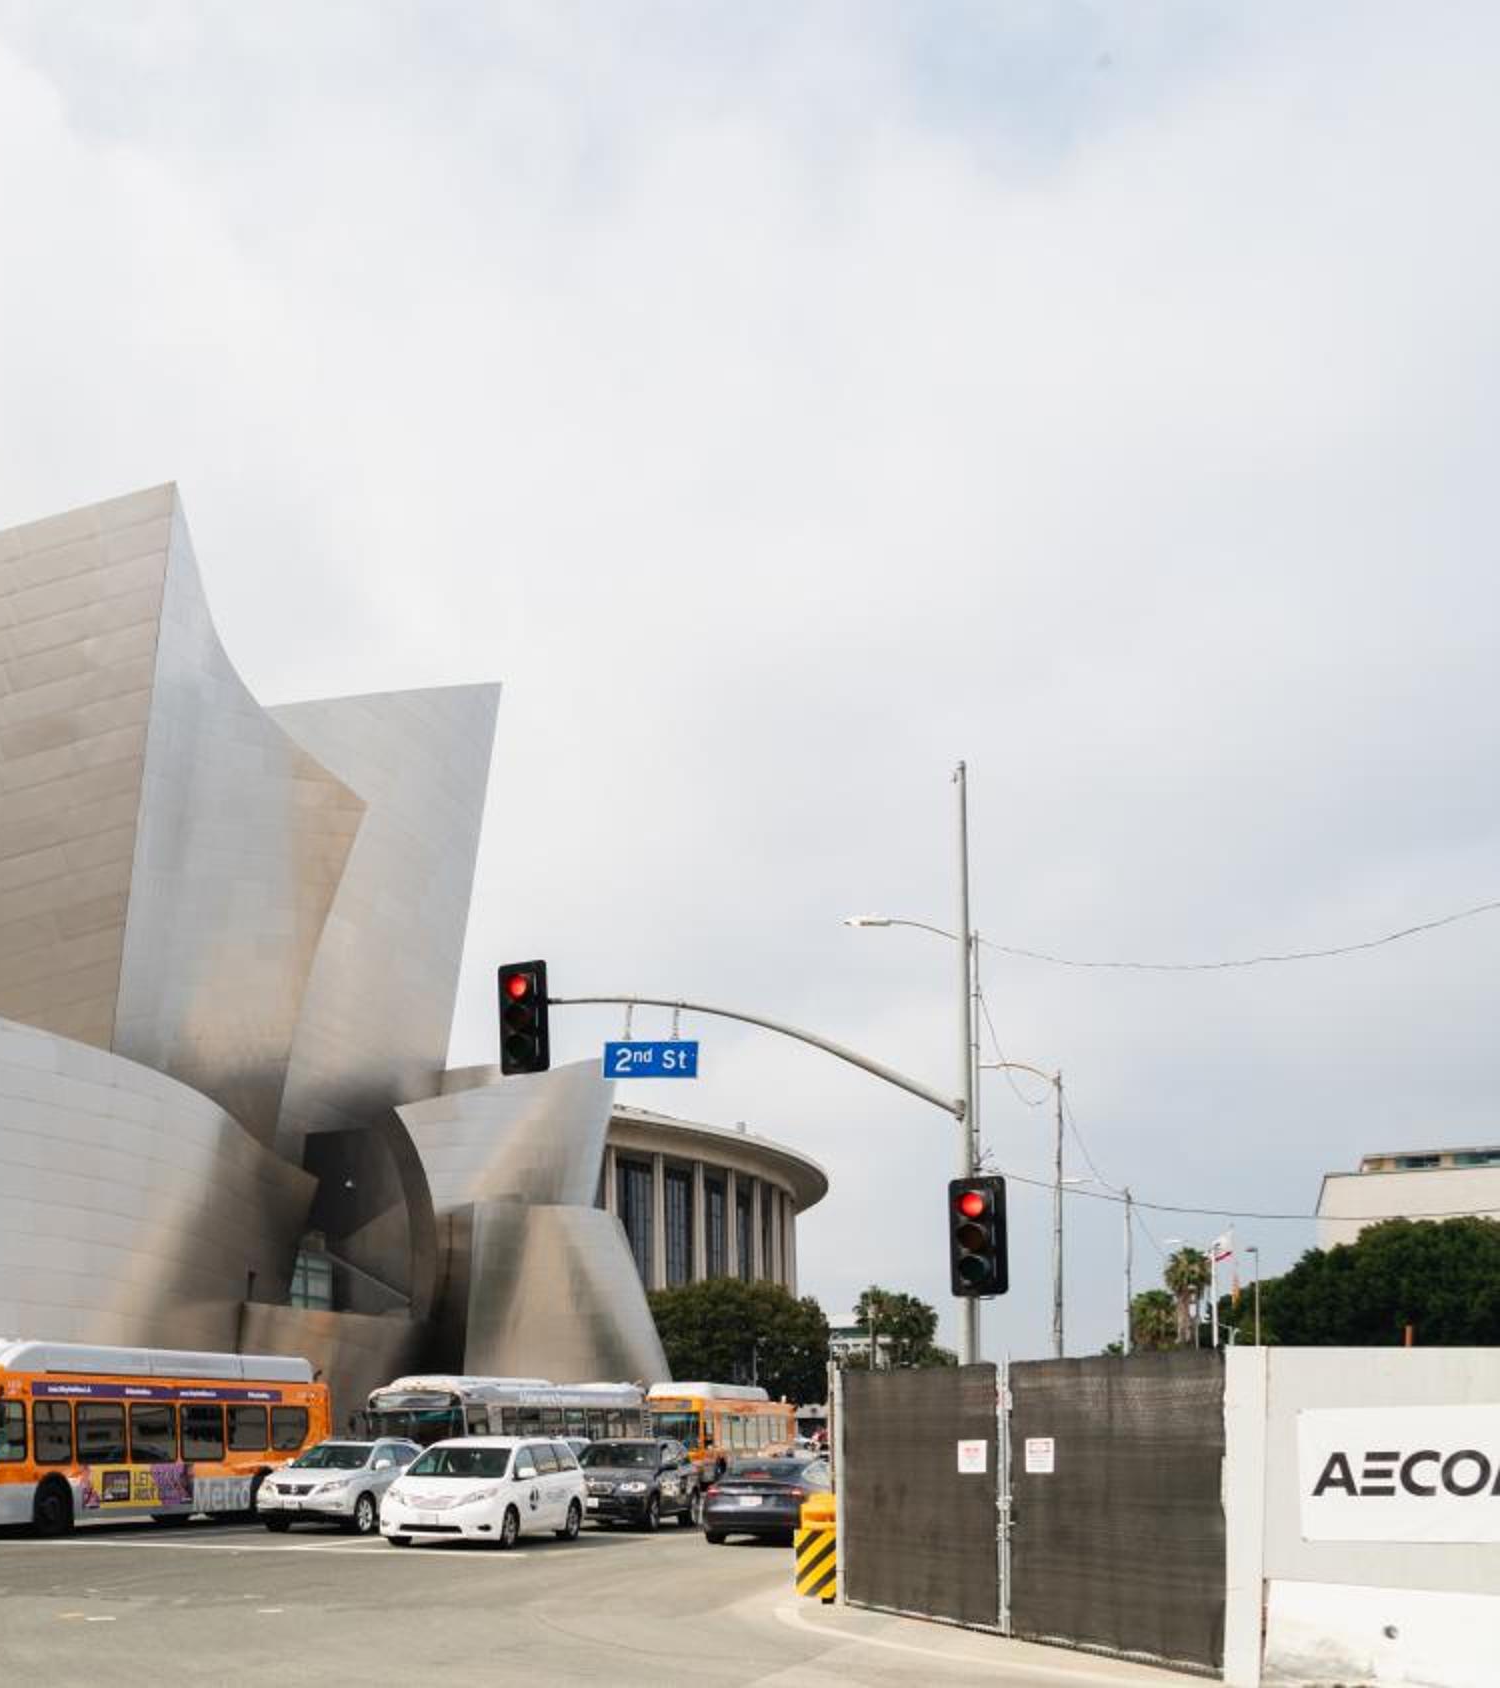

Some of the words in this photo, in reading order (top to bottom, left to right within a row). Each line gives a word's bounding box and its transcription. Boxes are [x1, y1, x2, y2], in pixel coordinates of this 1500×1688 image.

[615, 1048, 653, 1072] 2nd
[662, 1049, 687, 1069] St
[1312, 1449, 1500, 1497] AECO
[194, 1480, 251, 1512] Metro
